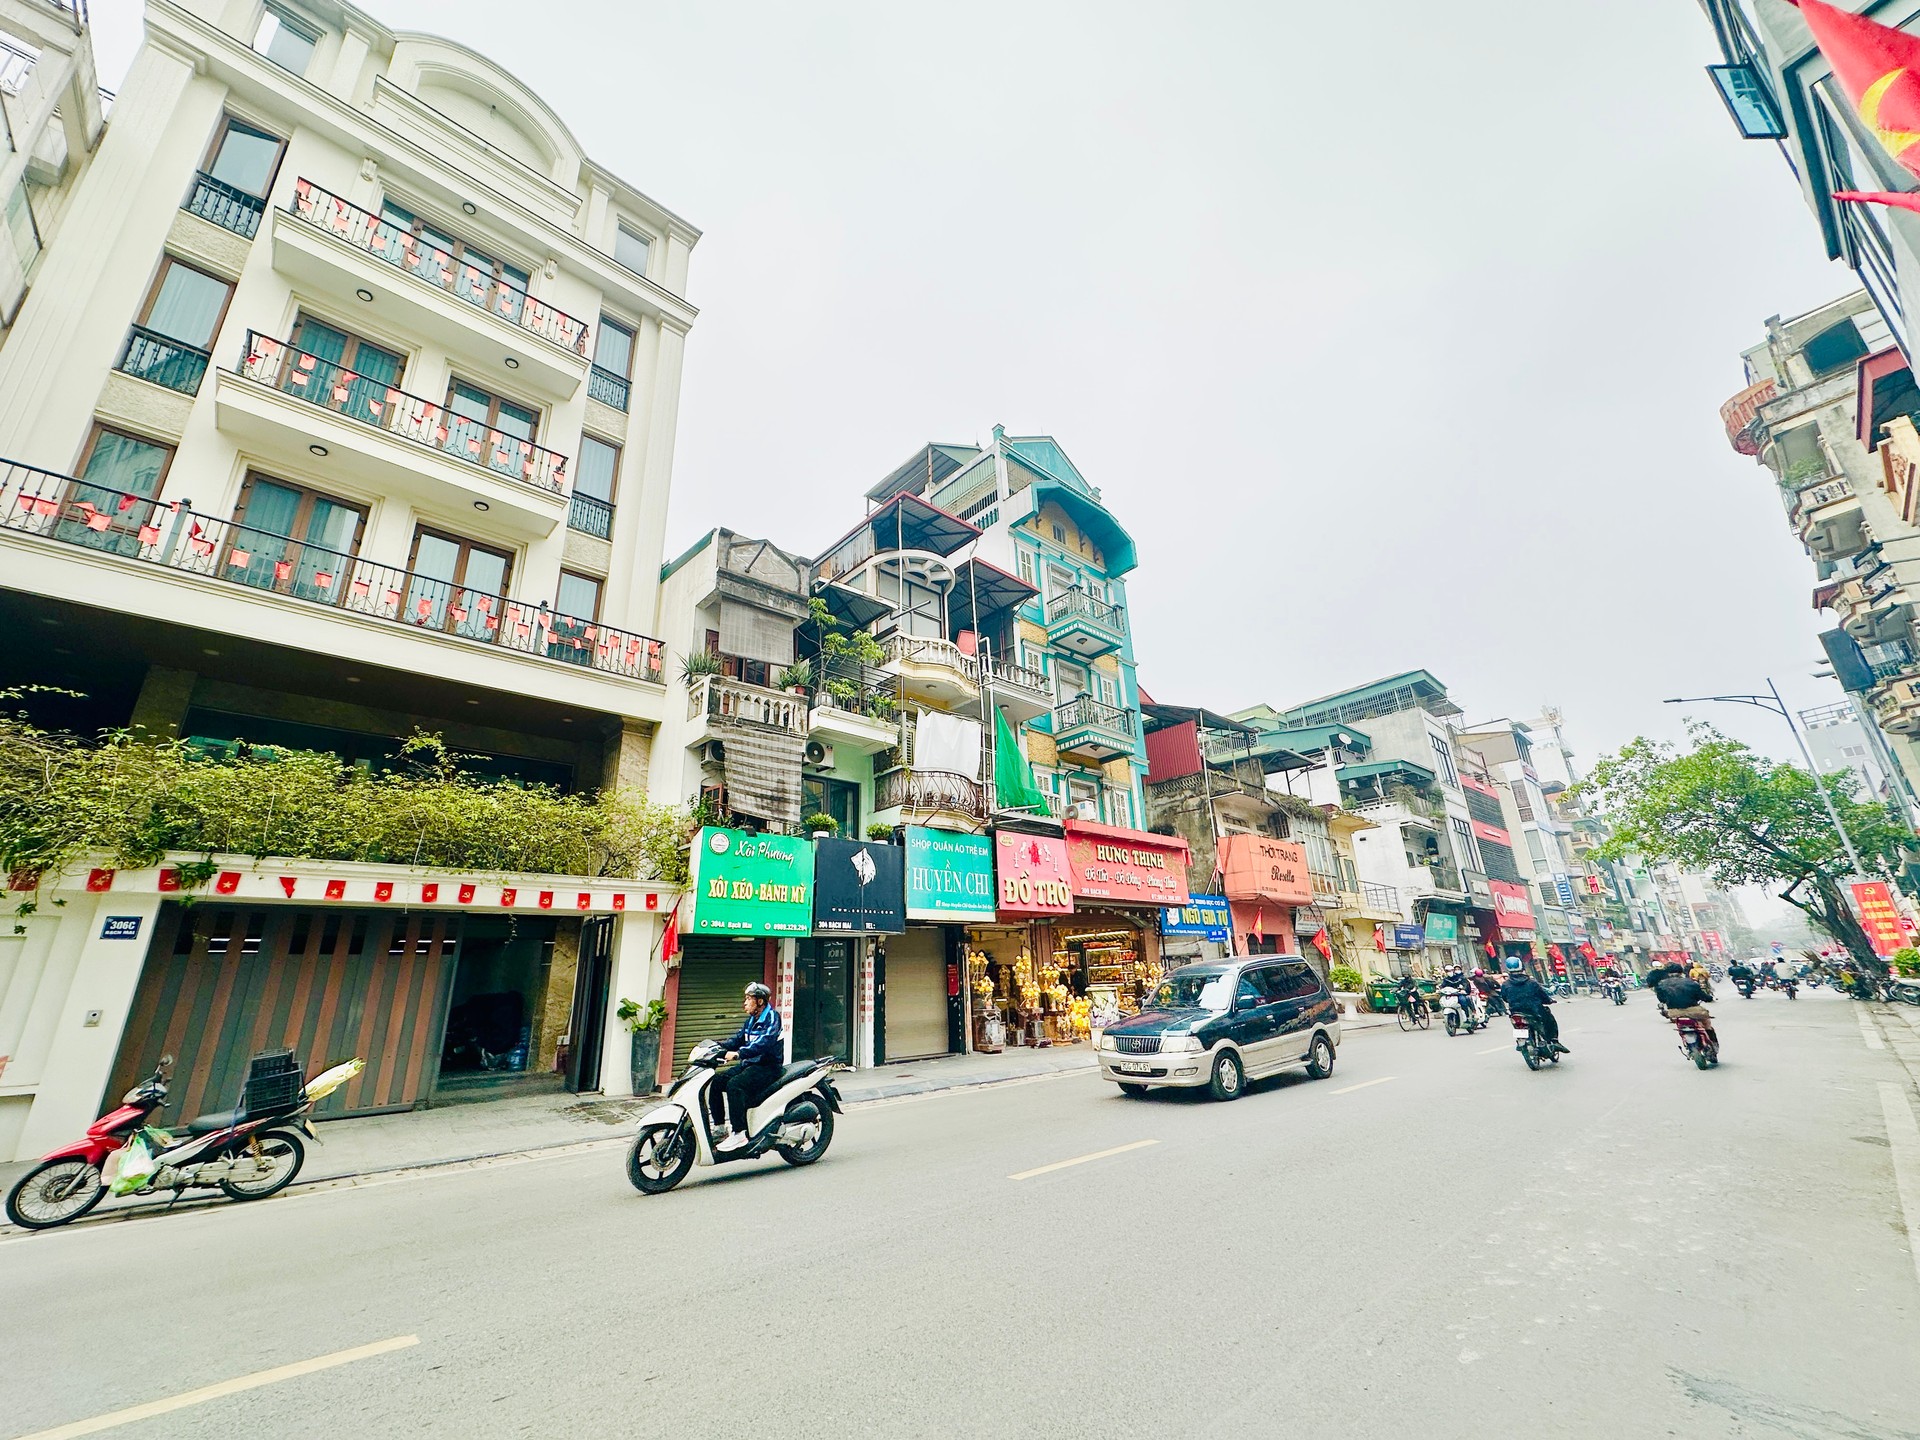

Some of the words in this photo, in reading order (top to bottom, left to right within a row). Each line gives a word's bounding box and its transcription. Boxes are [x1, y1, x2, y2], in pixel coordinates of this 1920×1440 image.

[911, 838, 932, 849] SHOP
[954, 842, 965, 853] ÁO
[978, 847, 989, 857] EM
[1096, 844, 1129, 864] HƯNG
[1131, 849, 1165, 871] THỊNH
[1276, 848, 1299, 863] TRANG
[912, 859, 963, 894] HUYỀN
[965, 872, 990, 896] CHI
[1004, 869, 1032, 904] ĐỒ
[1034, 875, 1072, 907] THỜ
[708, 874, 729, 898] XÔI
[731, 877, 753, 899] XÉO
[759, 880, 788, 902] BÁNH
[790, 883, 807, 904] MỲ
[110, 921, 136, 930] 306C
[818, 921, 828, 929] 304
[828, 921, 842, 930] BẠCH
[1182, 904, 1200, 925] NGÔ
[1201, 908, 1217, 926] GIA
